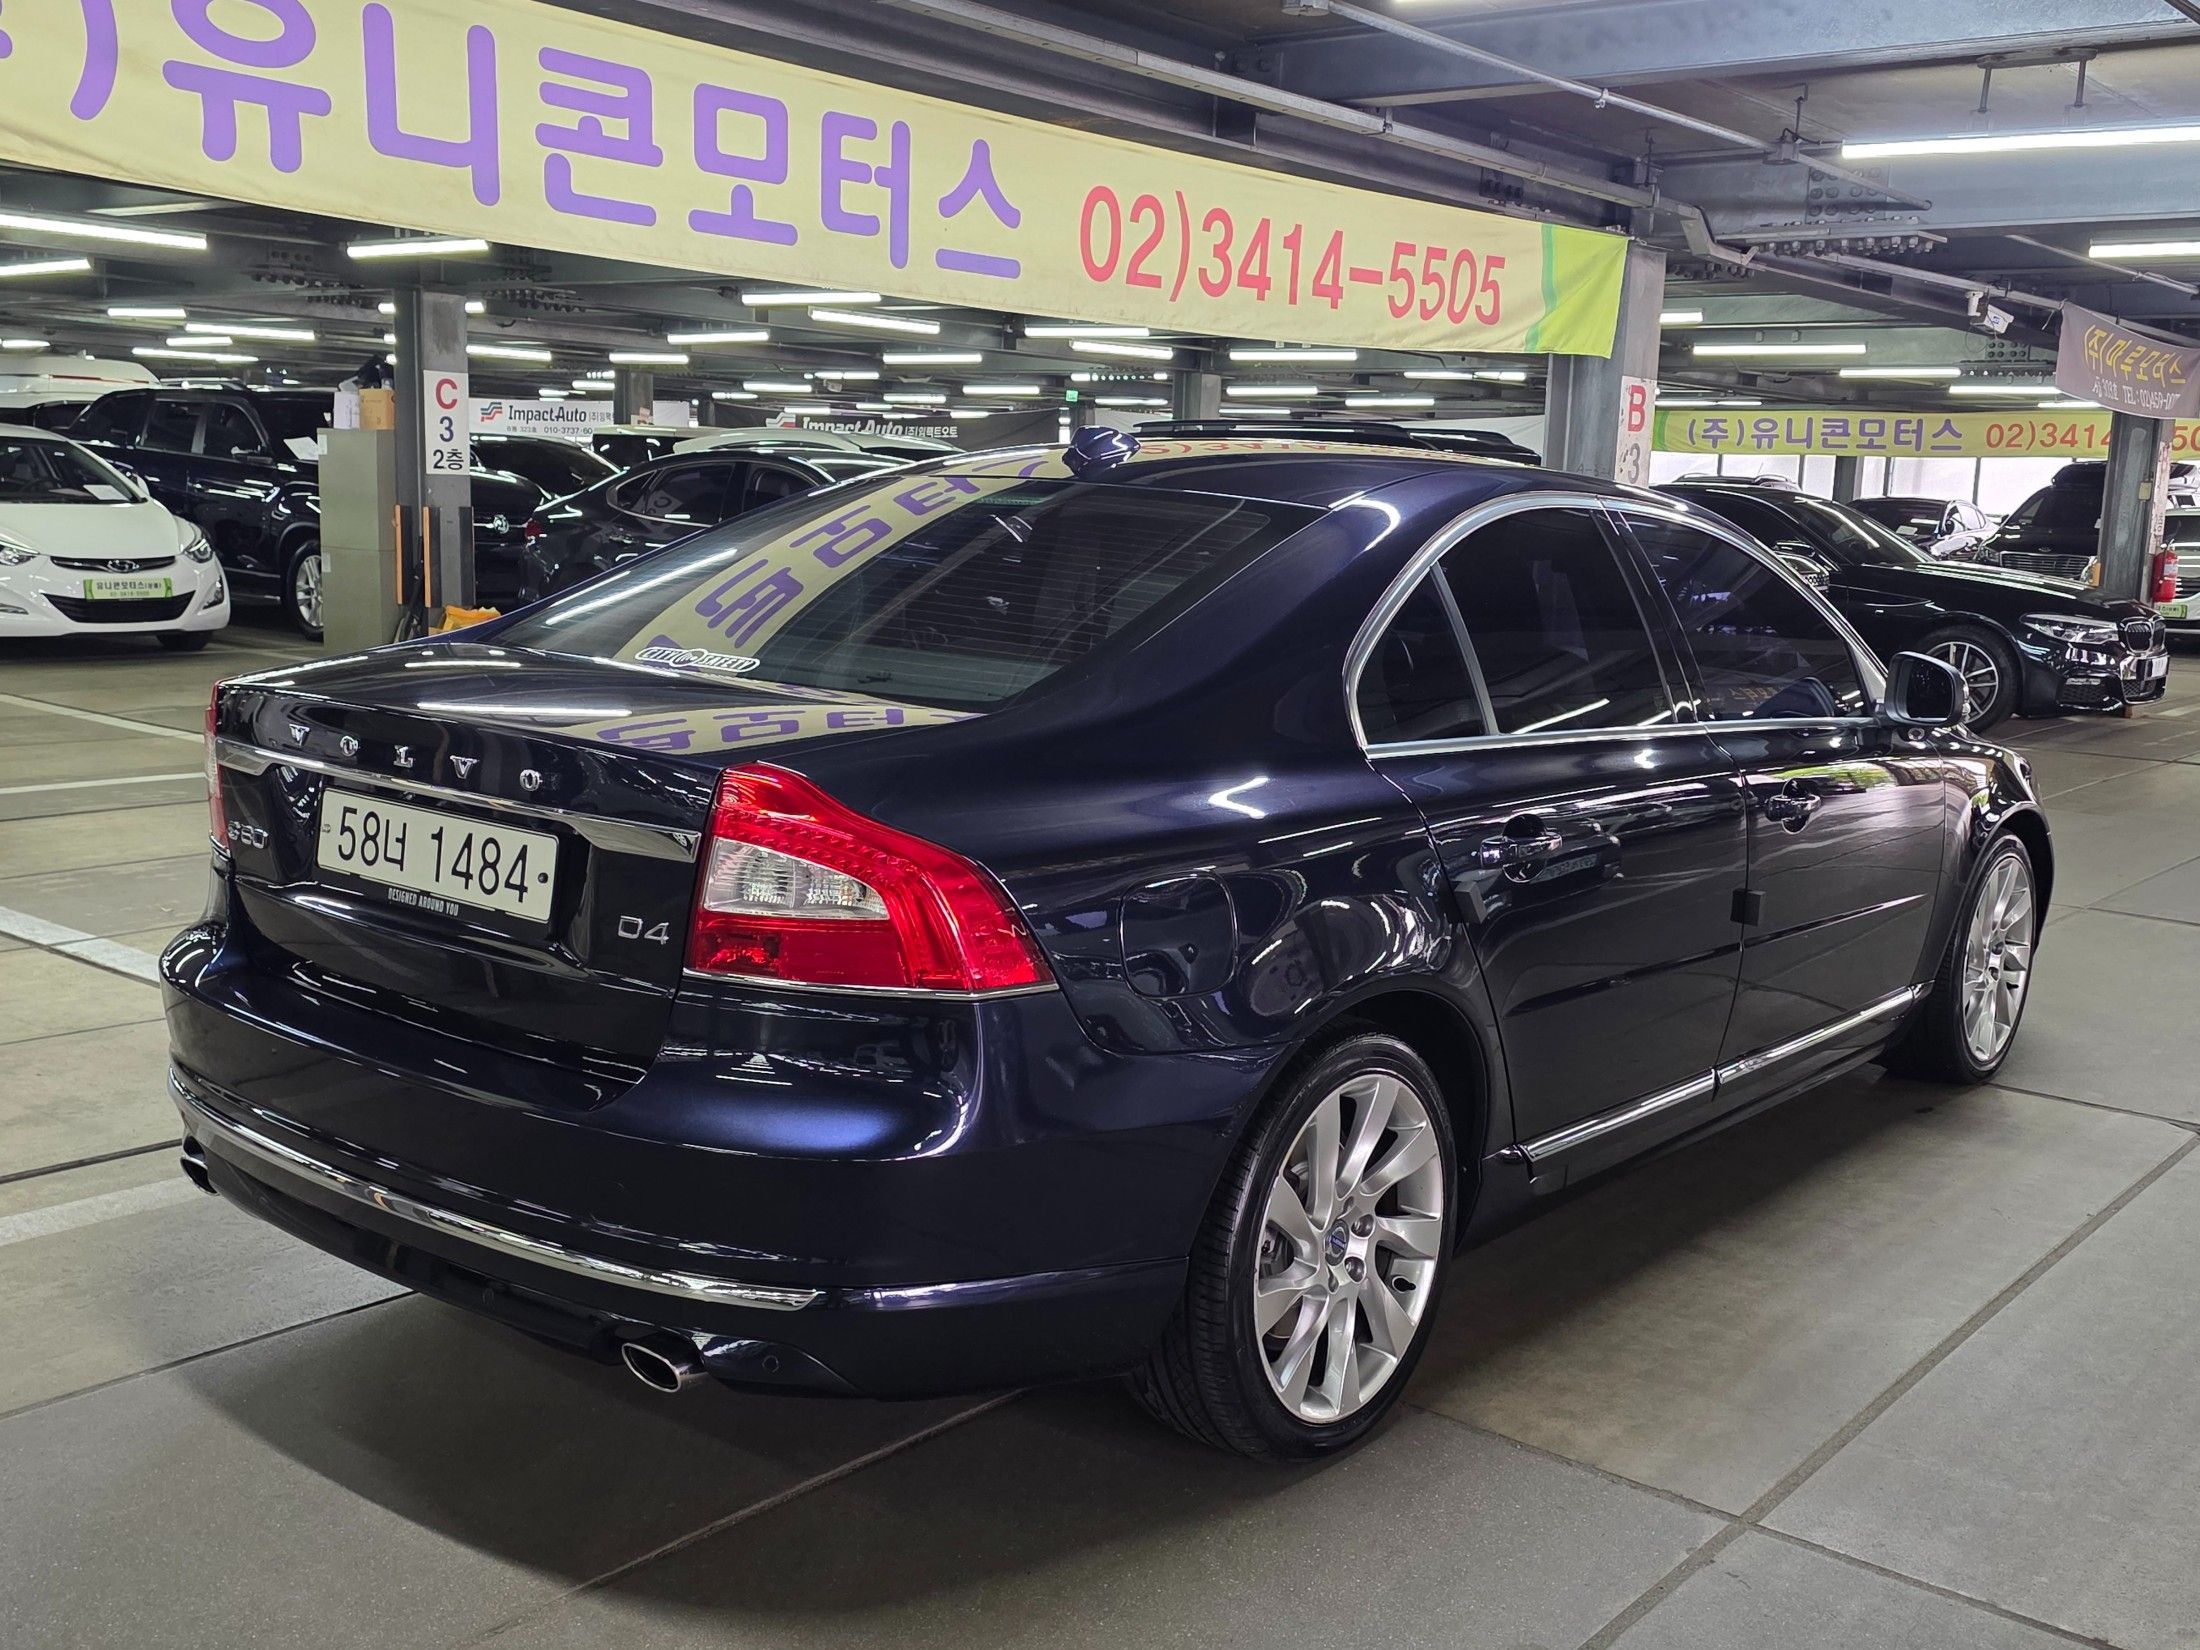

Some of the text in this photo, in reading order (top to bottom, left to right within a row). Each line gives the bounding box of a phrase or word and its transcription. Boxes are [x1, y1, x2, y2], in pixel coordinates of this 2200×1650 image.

[0, 0, 1506, 326] )유니콘모터스 02)3414-5505
[435, 378, 458, 410] C
[1627, 384, 1647, 433] B
[439, 416, 454, 442] 3
[1688, 416, 1963, 452] (주)유니콘모터스
[433, 448, 464, 470] 2층
[1628, 442, 1641, 484] 3
[698, 654, 755, 670] SAFETY
[289, 723, 542, 792] VOLVO
[227, 821, 269, 849] S80
[338, 806, 529, 903] 58너 1484
[387, 887, 460, 917] DESIGNED AROUND YOU
[618, 915, 670, 945] D4
